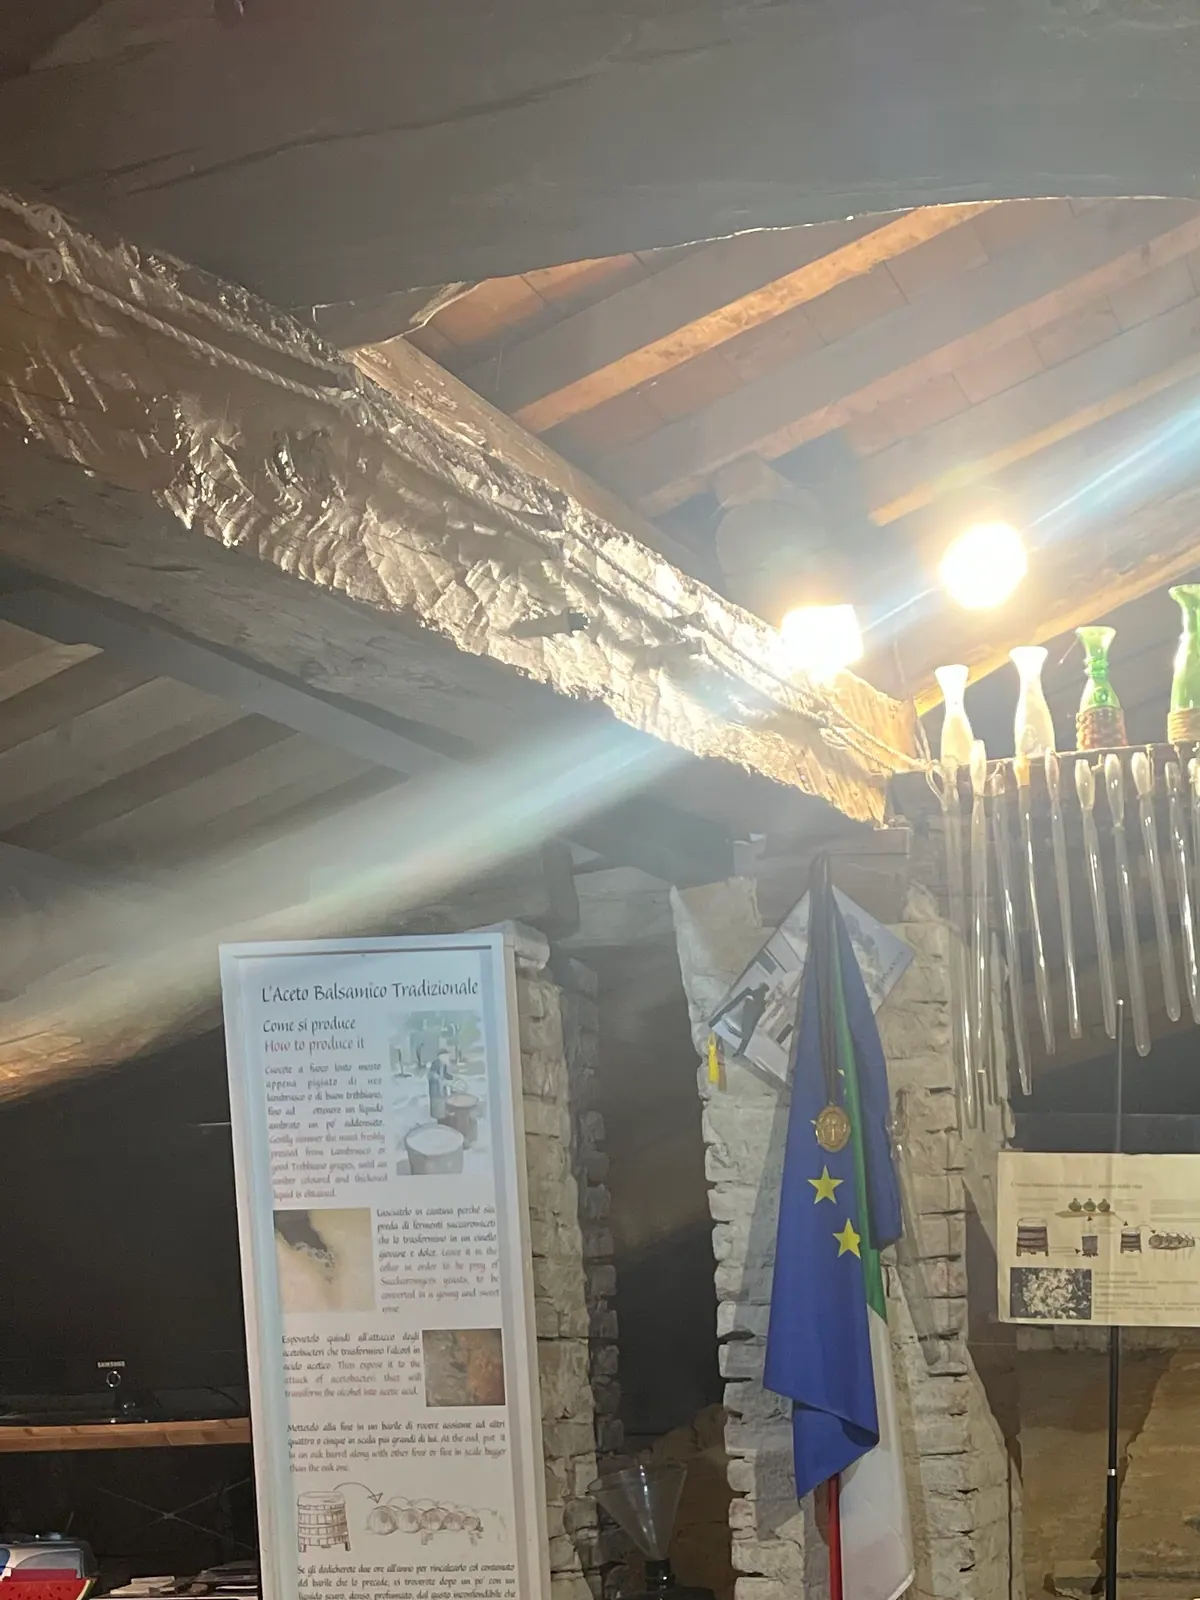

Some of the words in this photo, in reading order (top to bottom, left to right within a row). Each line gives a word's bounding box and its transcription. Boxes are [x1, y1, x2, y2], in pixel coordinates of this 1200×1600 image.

[262, 985, 308, 1002] L'Aceto
[314, 982, 387, 1000] Balsamico
[392, 976, 478, 997] Tradizionale
[263, 1020, 293, 1032] Come
[298, 1018, 308, 1031] si
[311, 1016, 355, 1035] produce
[265, 1040, 292, 1052] How
[295, 1038, 304, 1051] to
[309, 1036, 353, 1056] produce
[357, 1037, 364, 1049] it
[266, 1080, 296, 1090] appena
[308, 1079, 337, 1089] pigiato
[349, 1076, 356, 1085] di
[315, 1092, 322, 1100] di
[286, 1106, 295, 1115] ad
[377, 1221, 398, 1233] preda
[402, 1221, 409, 1229] di
[327, 1333, 350, 1345] quindi
[403, 1331, 419, 1343] degli
[327, 1347, 339, 1356] che
[283, 1361, 302, 1370] acido
[323, 1422, 336, 1431] alla
[340, 1422, 353, 1430] fine
[357, 1422, 364, 1430] in
[382, 1422, 401, 1430] barile
[405, 1421, 413, 1429] di
[476, 1420, 485, 1428] ad
[489, 1420, 504, 1428] altri
[297, 1566, 305, 1574] Se
[308, 1566, 316, 1577] gli
[358, 1564, 371, 1573] due
[416, 1566, 427, 1575] per
[298, 1579, 308, 1587] del
[312, 1578, 332, 1587] barile
[336, 1578, 348, 1586] che
[439, 1577, 457, 1588] dopo
[416, 1591, 428, 1599] dal
[504, 1589, 516, 1597] che
